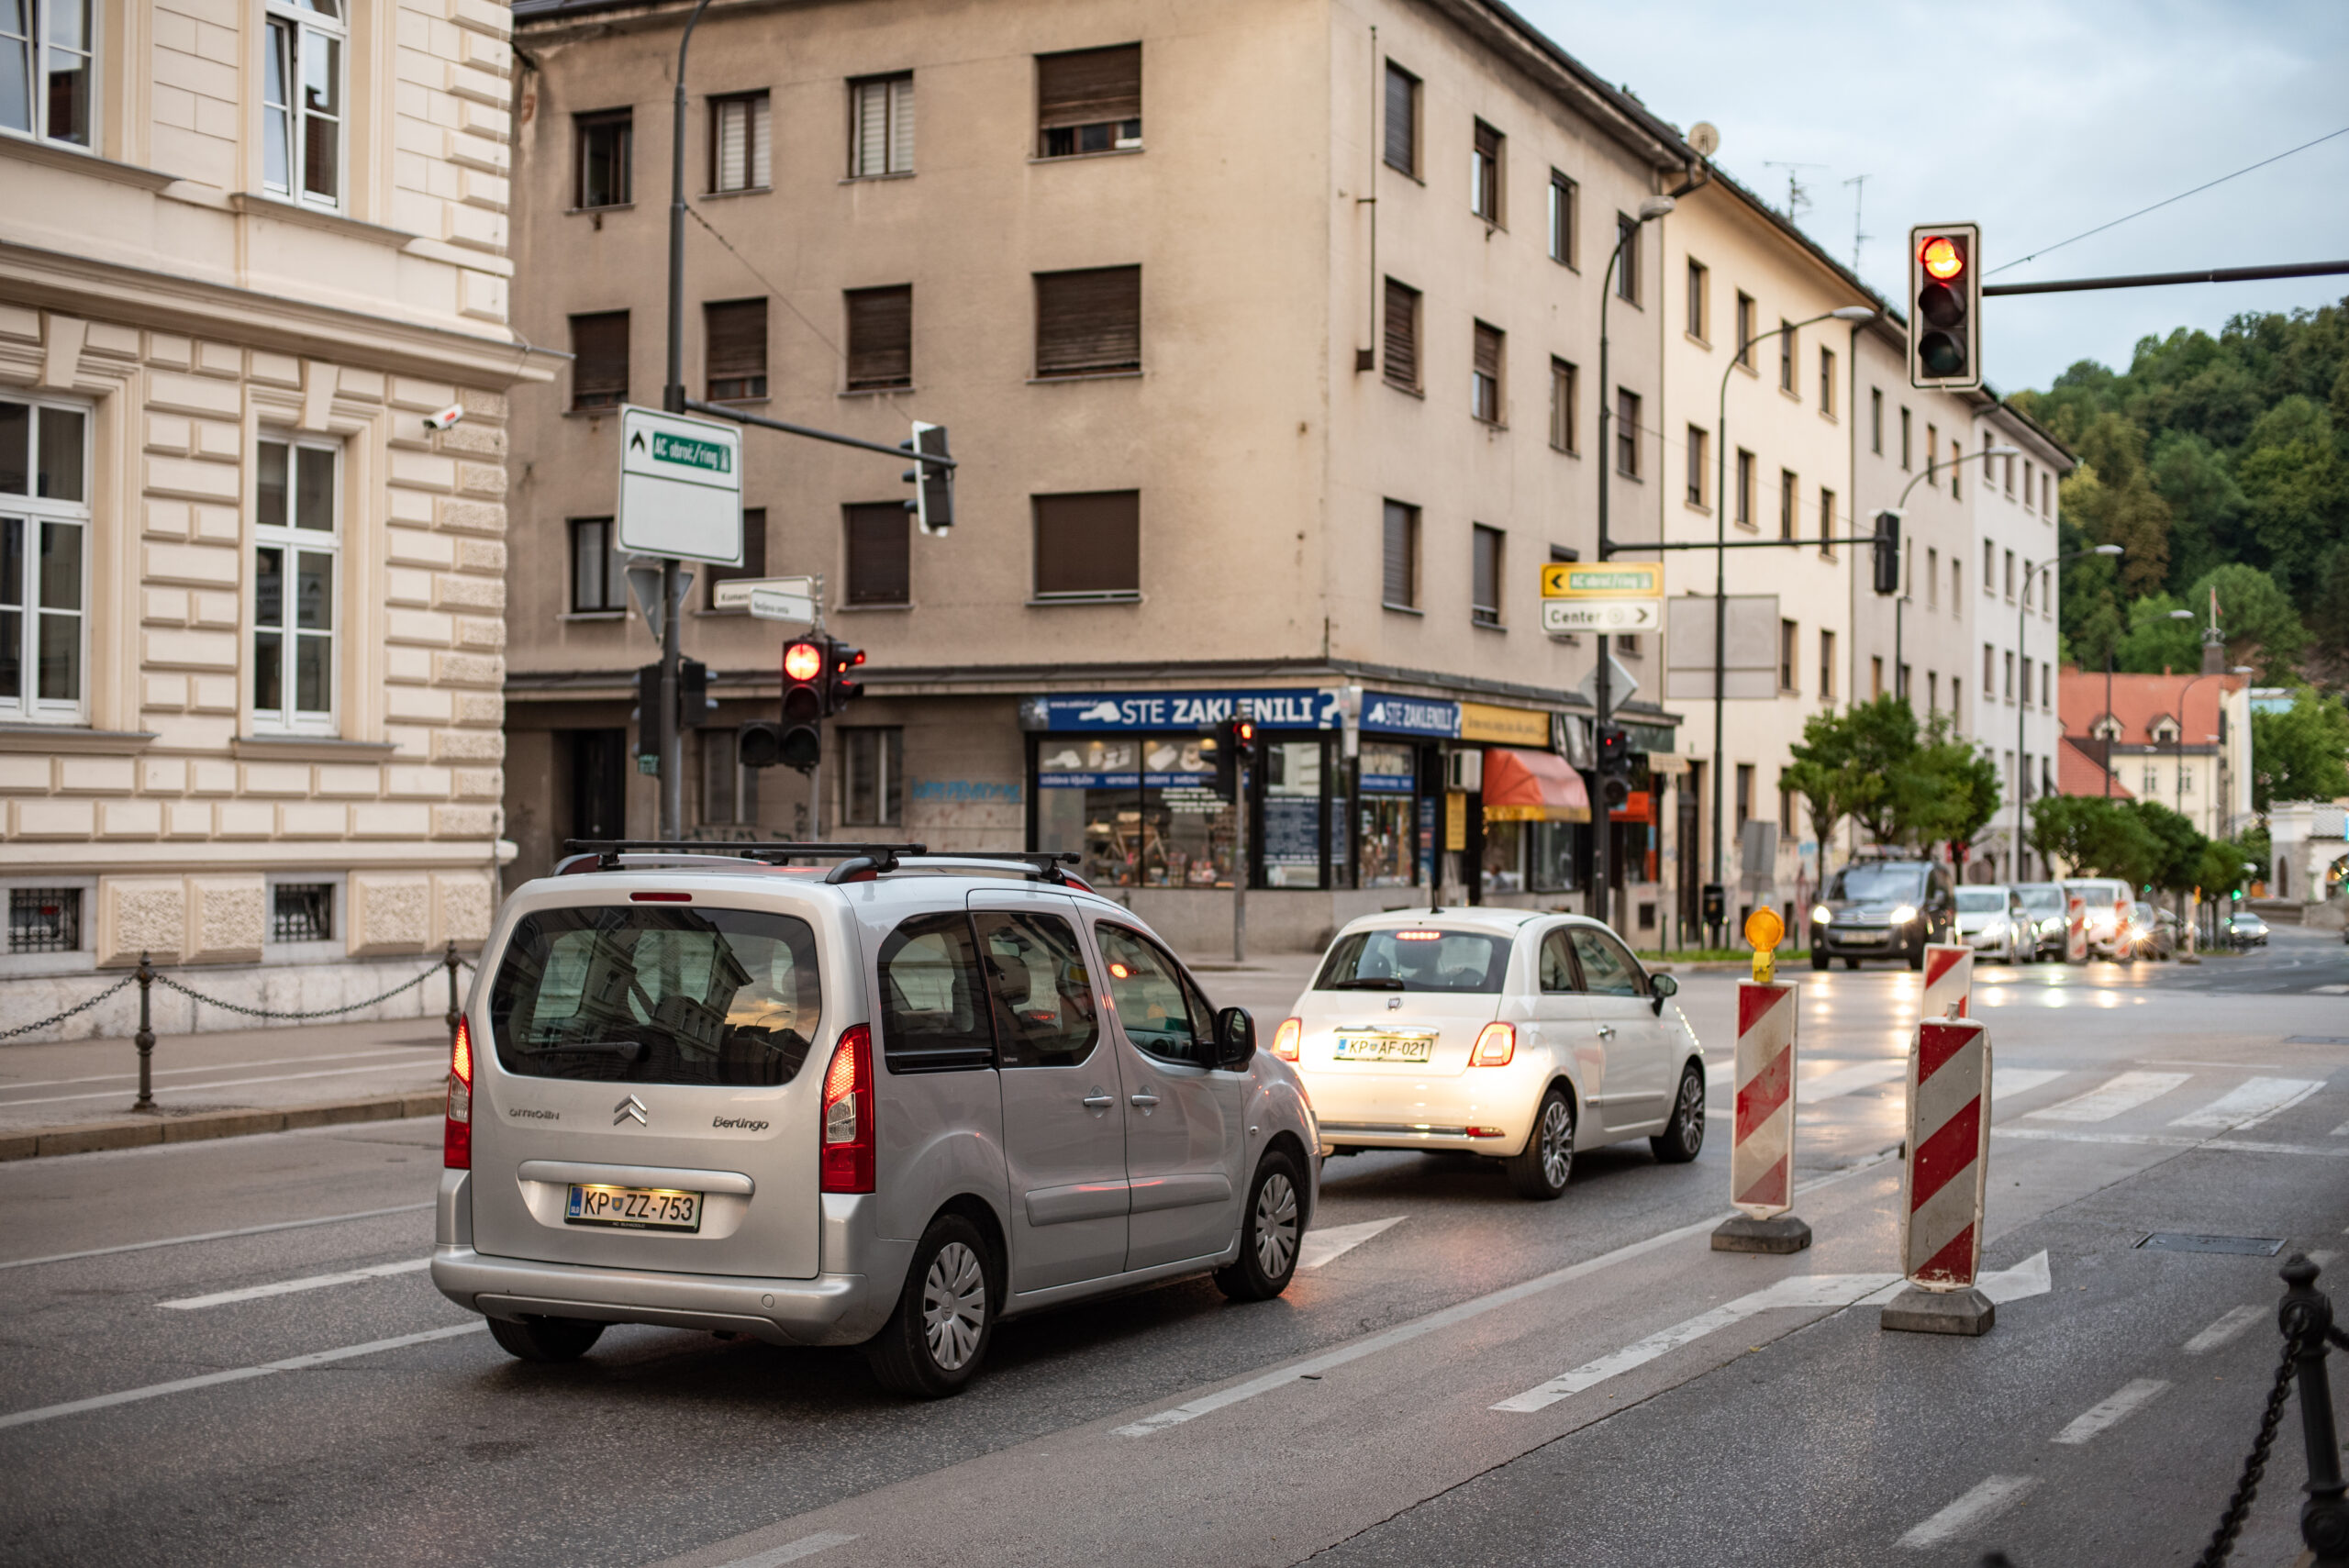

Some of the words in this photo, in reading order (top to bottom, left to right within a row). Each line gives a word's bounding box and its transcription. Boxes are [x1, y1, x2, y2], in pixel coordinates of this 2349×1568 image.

[654, 437, 668, 457] AC
[1551, 609, 1601, 623] Center
[1121, 699, 1165, 725] STE
[1386, 701, 1403, 727] STE
[1349, 1040, 1368, 1054] KP
[1378, 1040, 1425, 1056] AF-021
[712, 1116, 770, 1131] Berlingo
[584, 1191, 609, 1215] KP
[625, 1194, 694, 1221] ZZ-753
